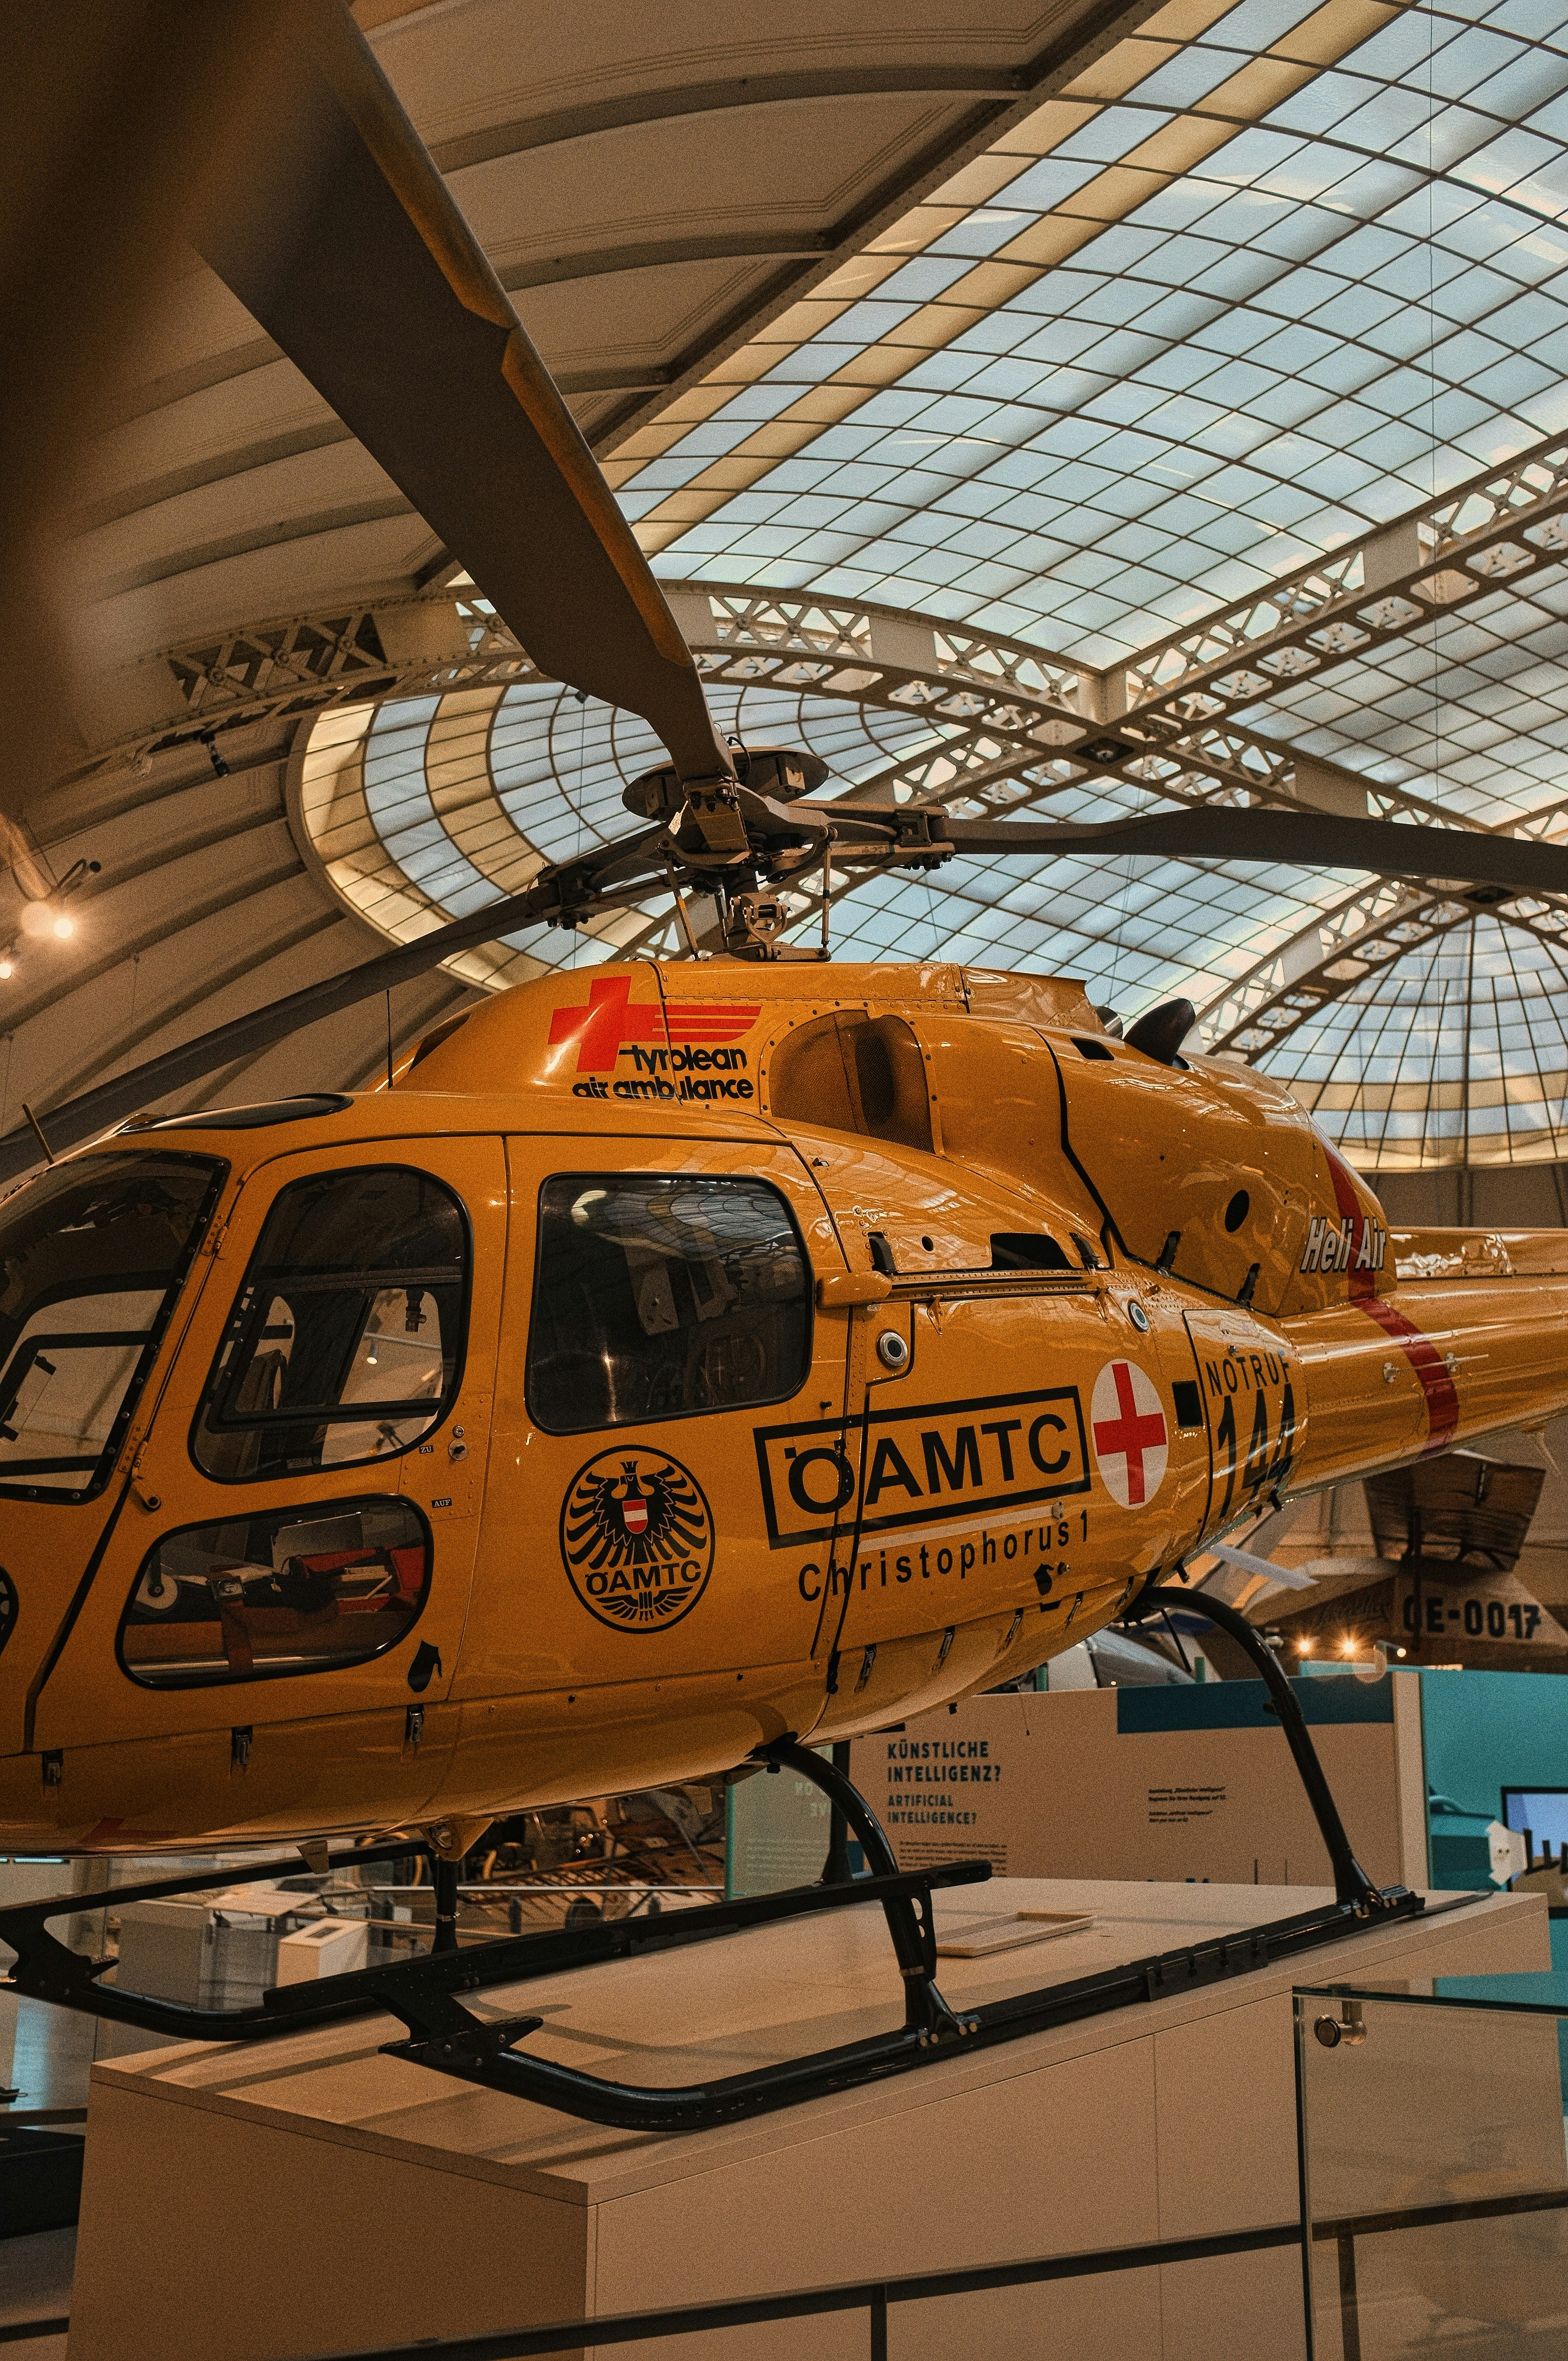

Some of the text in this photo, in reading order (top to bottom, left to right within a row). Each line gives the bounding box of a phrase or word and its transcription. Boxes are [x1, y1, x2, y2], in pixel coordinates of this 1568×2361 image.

[618, 1045, 748, 1075] tyrolean
[572, 1075, 754, 1101] air ambulance
[1300, 1217, 1387, 1274] Heli Air
[1205, 1352, 1291, 1397] NOTRUF
[784, 1413, 1072, 1515] ÖAMTC
[1217, 1383, 1295, 1519] 144
[434, 1499, 451, 1508] AUF
[798, 1509, 1088, 1602] Christophorus 1
[584, 1560, 701, 1596] ÖAMTC
[888, 1738, 990, 1759] KÜNSTLICHE
[888, 1765, 1001, 1782] INTELLIGENZ?
[888, 1794, 954, 1807] ARTIFICIAL
[888, 1811, 977, 1824] INTELLIGENCE?
